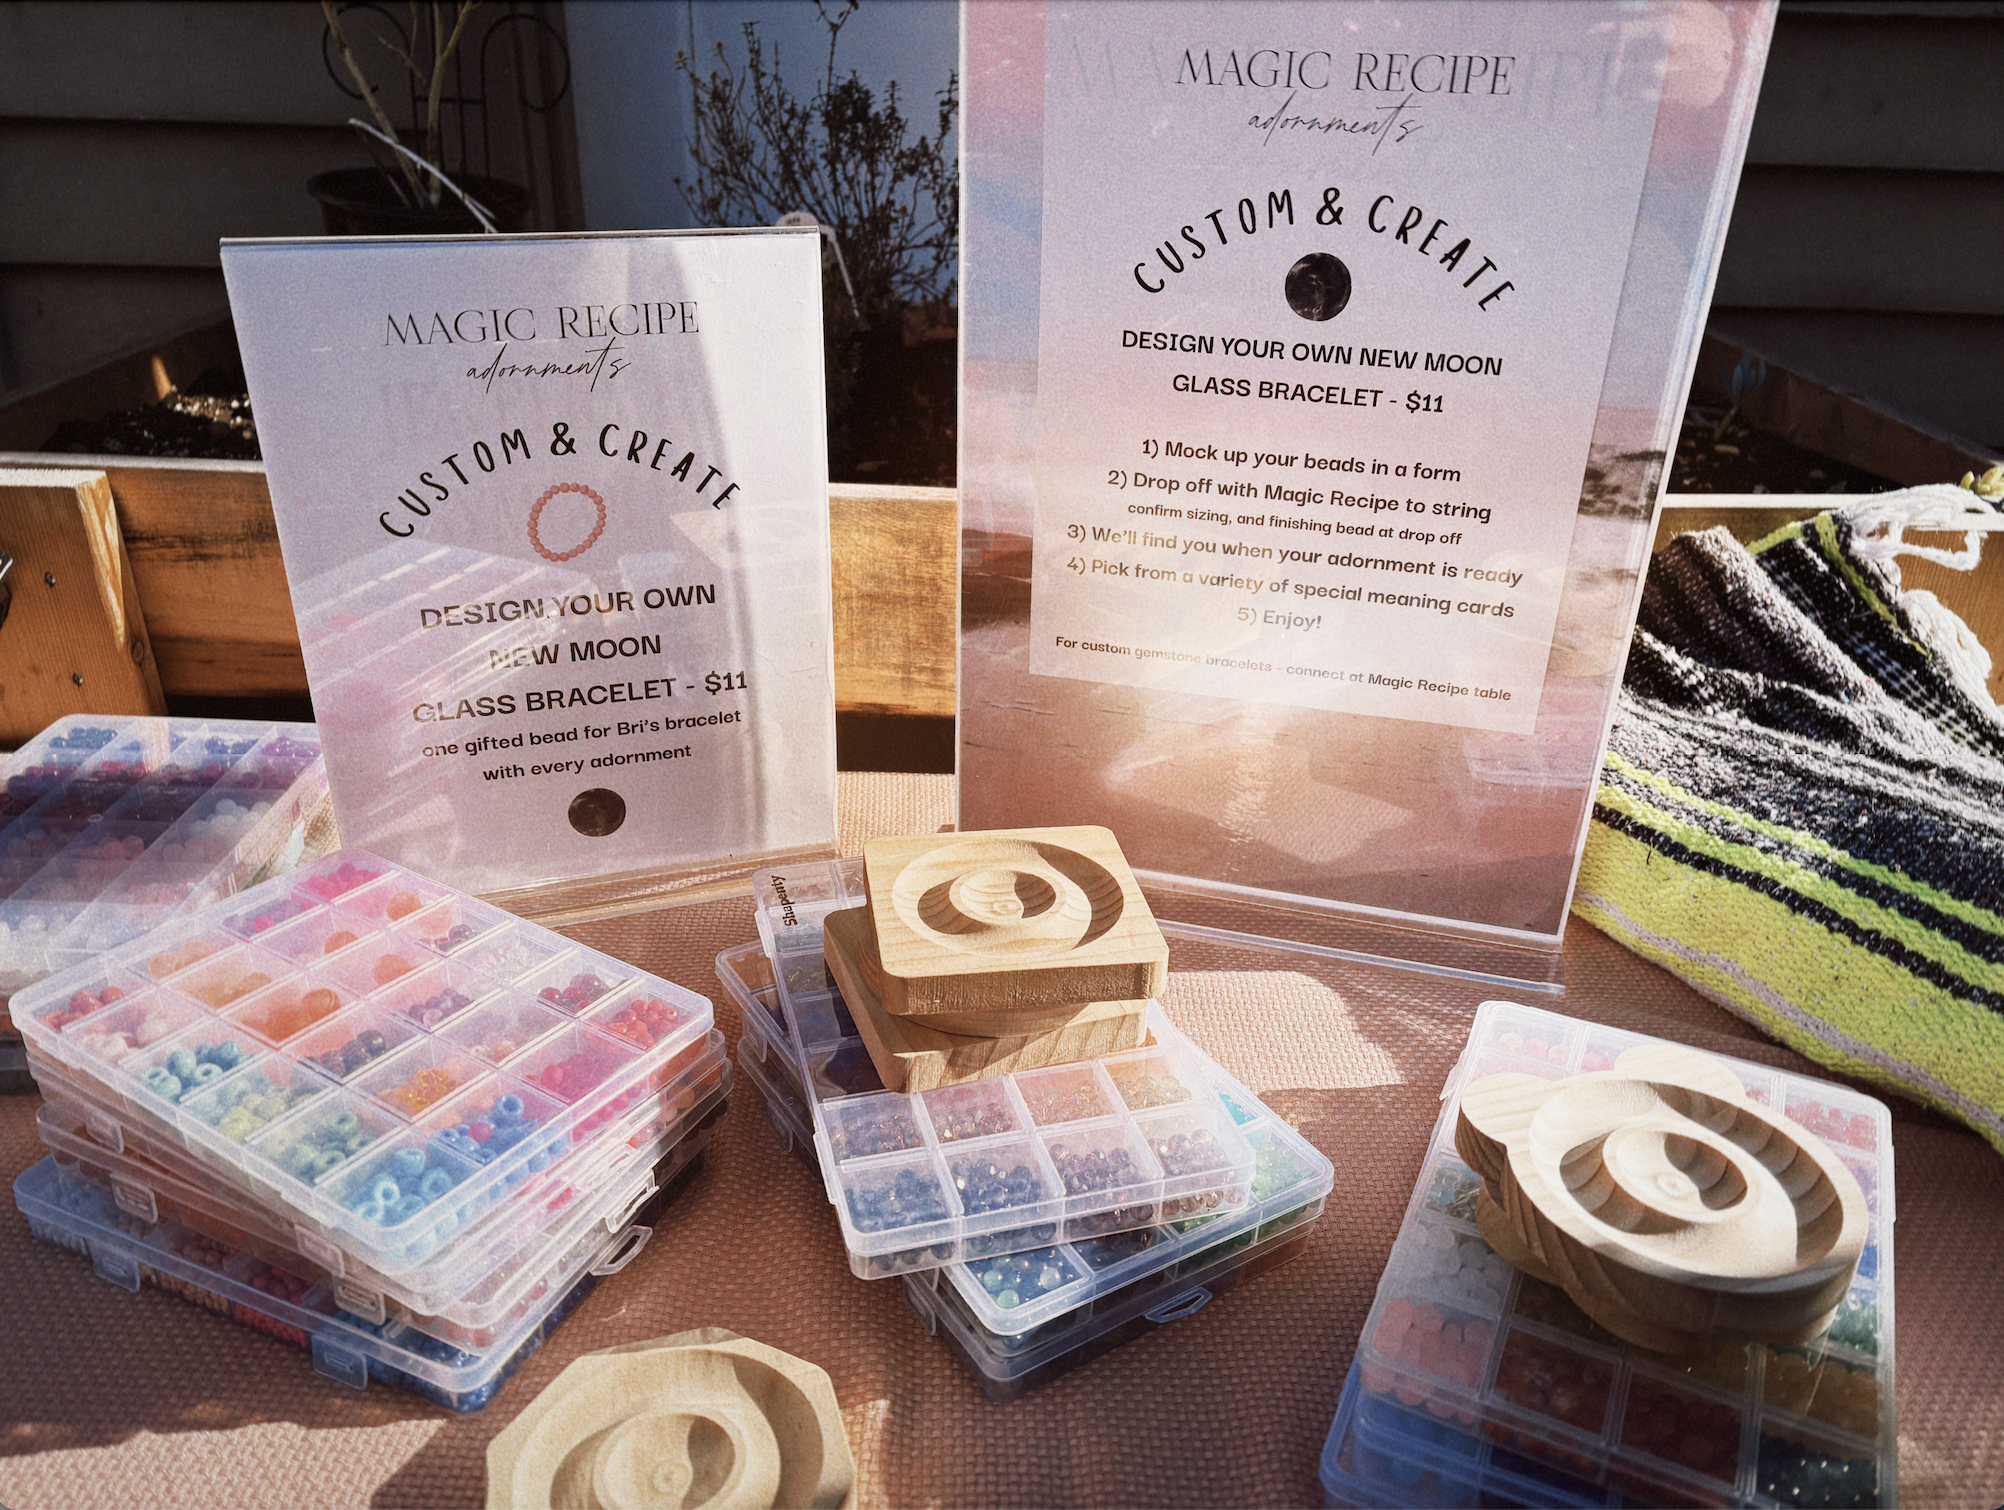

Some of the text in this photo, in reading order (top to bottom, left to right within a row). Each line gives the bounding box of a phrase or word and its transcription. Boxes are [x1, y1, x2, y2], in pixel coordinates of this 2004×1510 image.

[1174, 48, 1331, 90] MAGIC
[1354, 51, 1517, 97] RECIPE
[1134, 187, 1515, 312] CUSTOM & CREATE
[383, 301, 700, 346] MAGIC RECIPE
[1121, 330, 1503, 376] DESIGN YOUR OWN NEW MOON
[1173, 374, 1252, 398] GLASS
[1258, 380, 1383, 408] BRACELET
[1405, 390, 1444, 414] $11
[379, 422, 741, 538] CUSTOM & CREATE
[1141, 438, 1461, 483] 1) Mock up your beads in a form
[1107, 469, 1492, 524] 2) Drop off with Magic Recipe to string
[1127, 502, 1463, 546] confirm sizing, and finishing bead at drop off
[1066, 522, 1087, 544] 3)
[1142, 531, 1178, 550] find
[1182, 539, 1217, 556] you
[1221, 538, 1273, 560] when
[1278, 546, 1322, 565] your
[1327, 551, 1436, 575] adornment
[1441, 560, 1458, 578] is
[1463, 564, 1524, 588] ready
[420, 584, 717, 630] DESIGN YOUR OWN
[1066, 556, 1516, 619] 4) Pick from a variety of special meaning cards
[1236, 605, 1322, 632] 5) Enjoy!
[489, 634, 662, 670] NEW MOON
[1055, 636, 1078, 650] For
[1081, 639, 1132, 656] custom
[1134, 644, 1202, 666] gemstone
[1205, 654, 1272, 672] bracelets
[1285, 663, 1345, 682] connect
[1348, 670, 1364, 684] at
[1368, 672, 1413, 691] Magic
[1417, 678, 1470, 698] Recipe
[1473, 684, 1512, 701] table
[412, 694, 517, 723] GLASS
[526, 677, 677, 713] BRACELET
[705, 671, 747, 696] $11
[422, 741, 459, 758] one
[465, 732, 524, 757] gifted
[529, 725, 579, 746] bead
[583, 722, 611, 740] for
[665, 709, 741, 731] bracelet
[482, 744, 693, 781] with every adornment
